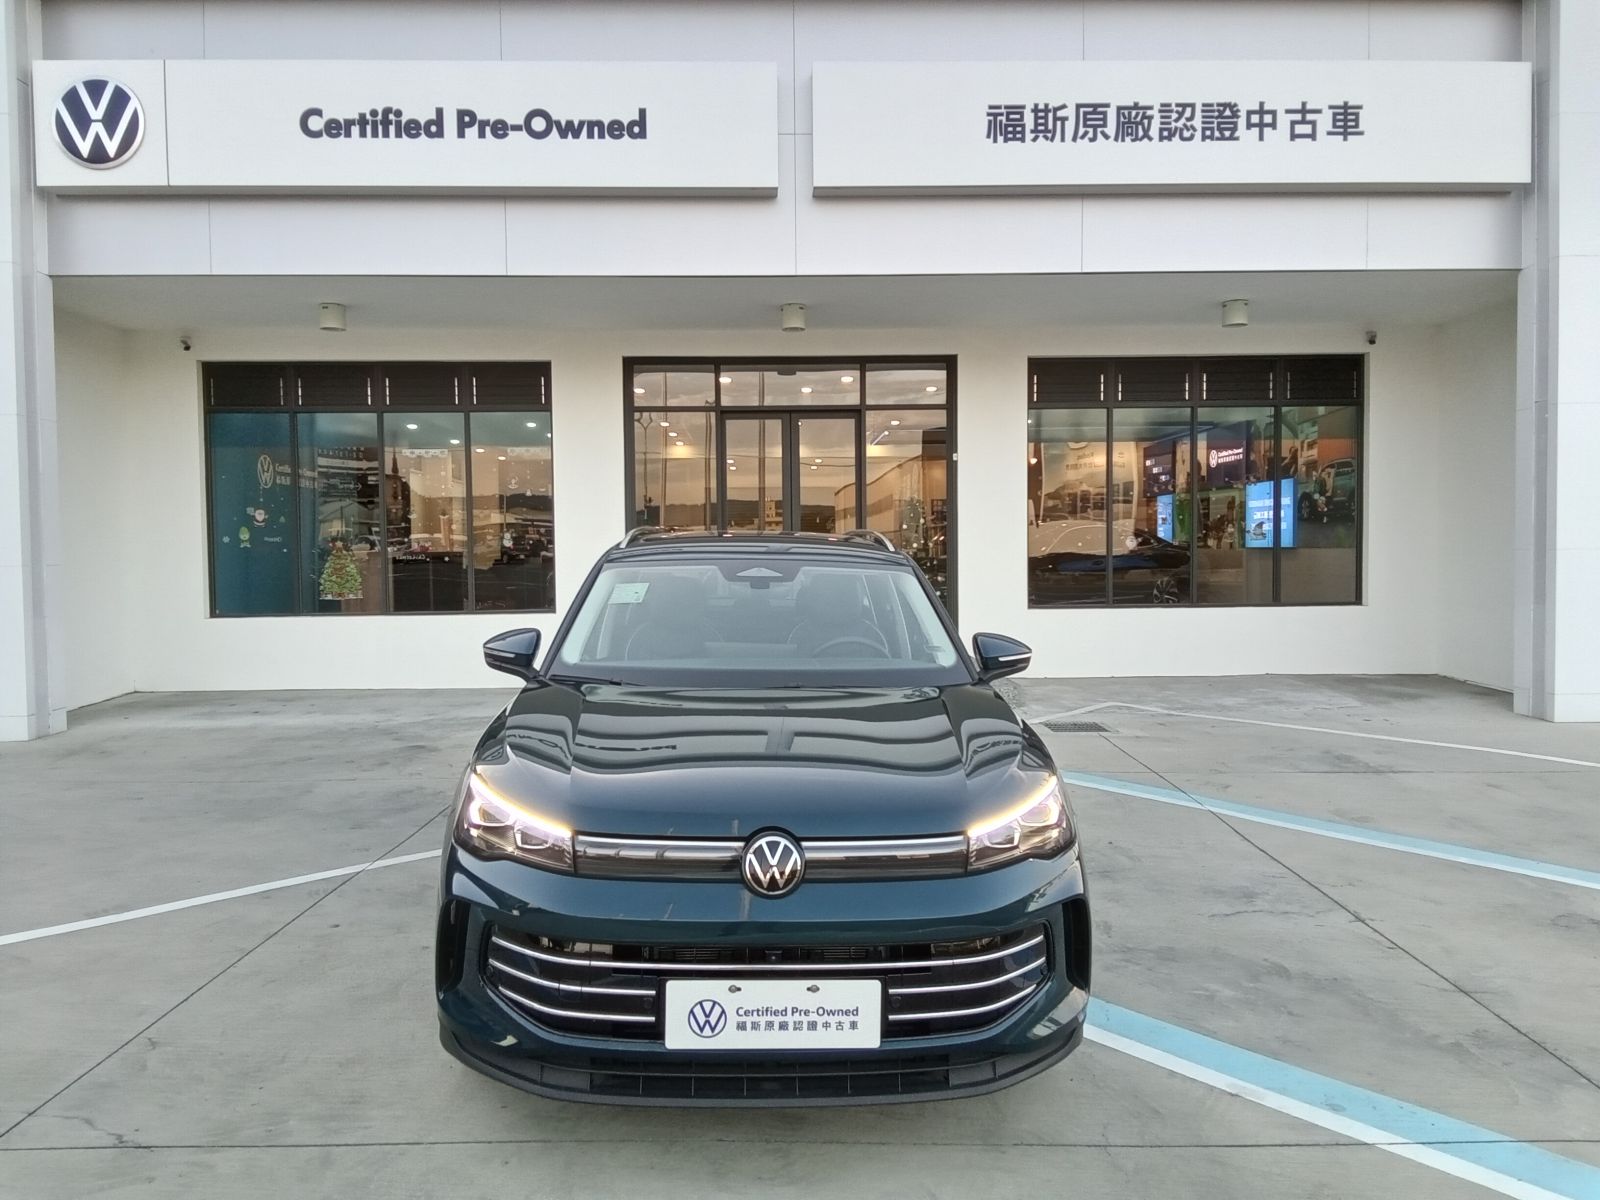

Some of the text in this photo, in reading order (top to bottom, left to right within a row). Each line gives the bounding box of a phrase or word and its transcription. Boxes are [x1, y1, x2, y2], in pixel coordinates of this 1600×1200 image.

[54, 77, 141, 167] VW
[300, 107, 647, 139] Certified Pre-Owned
[986, 101, 1365, 144] 福斯原廠認證中古車
[745, 836, 801, 894] VW
[688, 999, 727, 1038] VW
[736, 1006, 859, 1017] Certified Pre-Owned
[736, 1020, 859, 1032] 福斯原廠認證中古車
